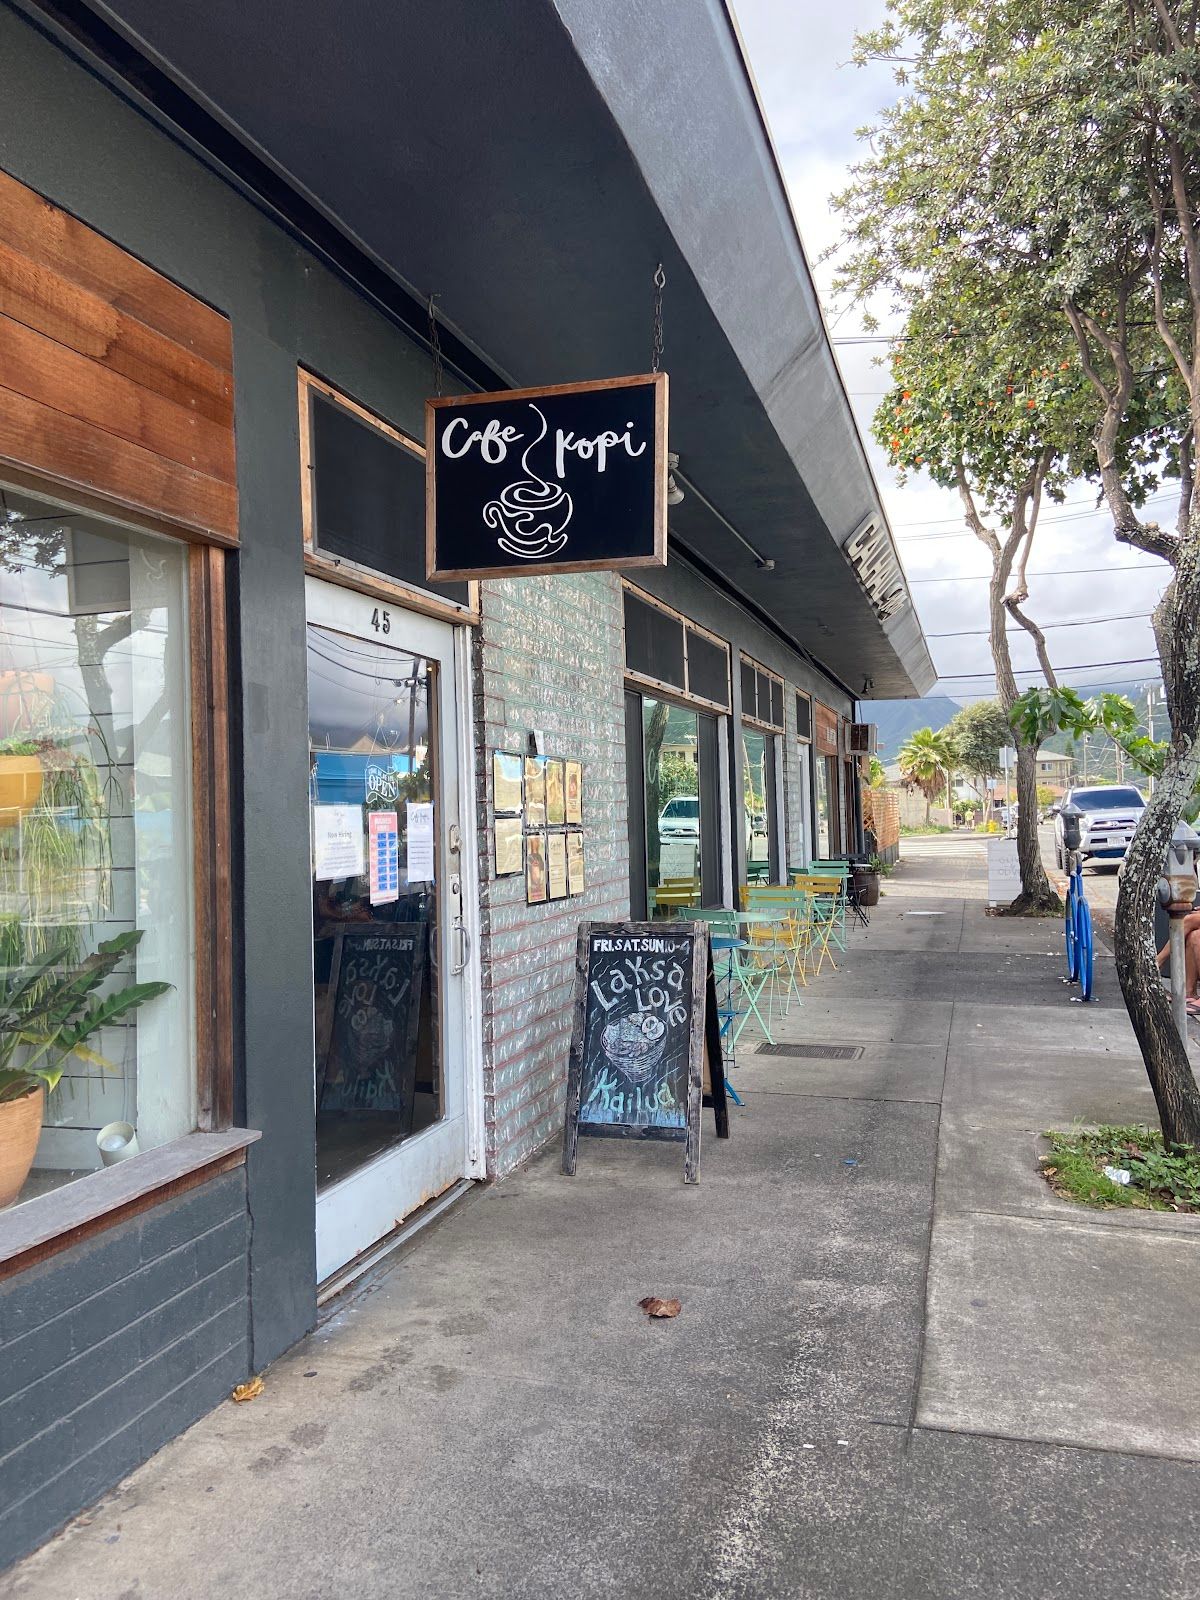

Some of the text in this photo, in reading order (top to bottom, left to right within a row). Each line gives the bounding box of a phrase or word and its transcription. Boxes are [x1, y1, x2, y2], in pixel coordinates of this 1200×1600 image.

[441, 417, 524, 464] Cafe
[371, 607, 391, 635] 45
[368, 774, 396, 797] OPEN
[583, 1068, 675, 1113] Kailua
